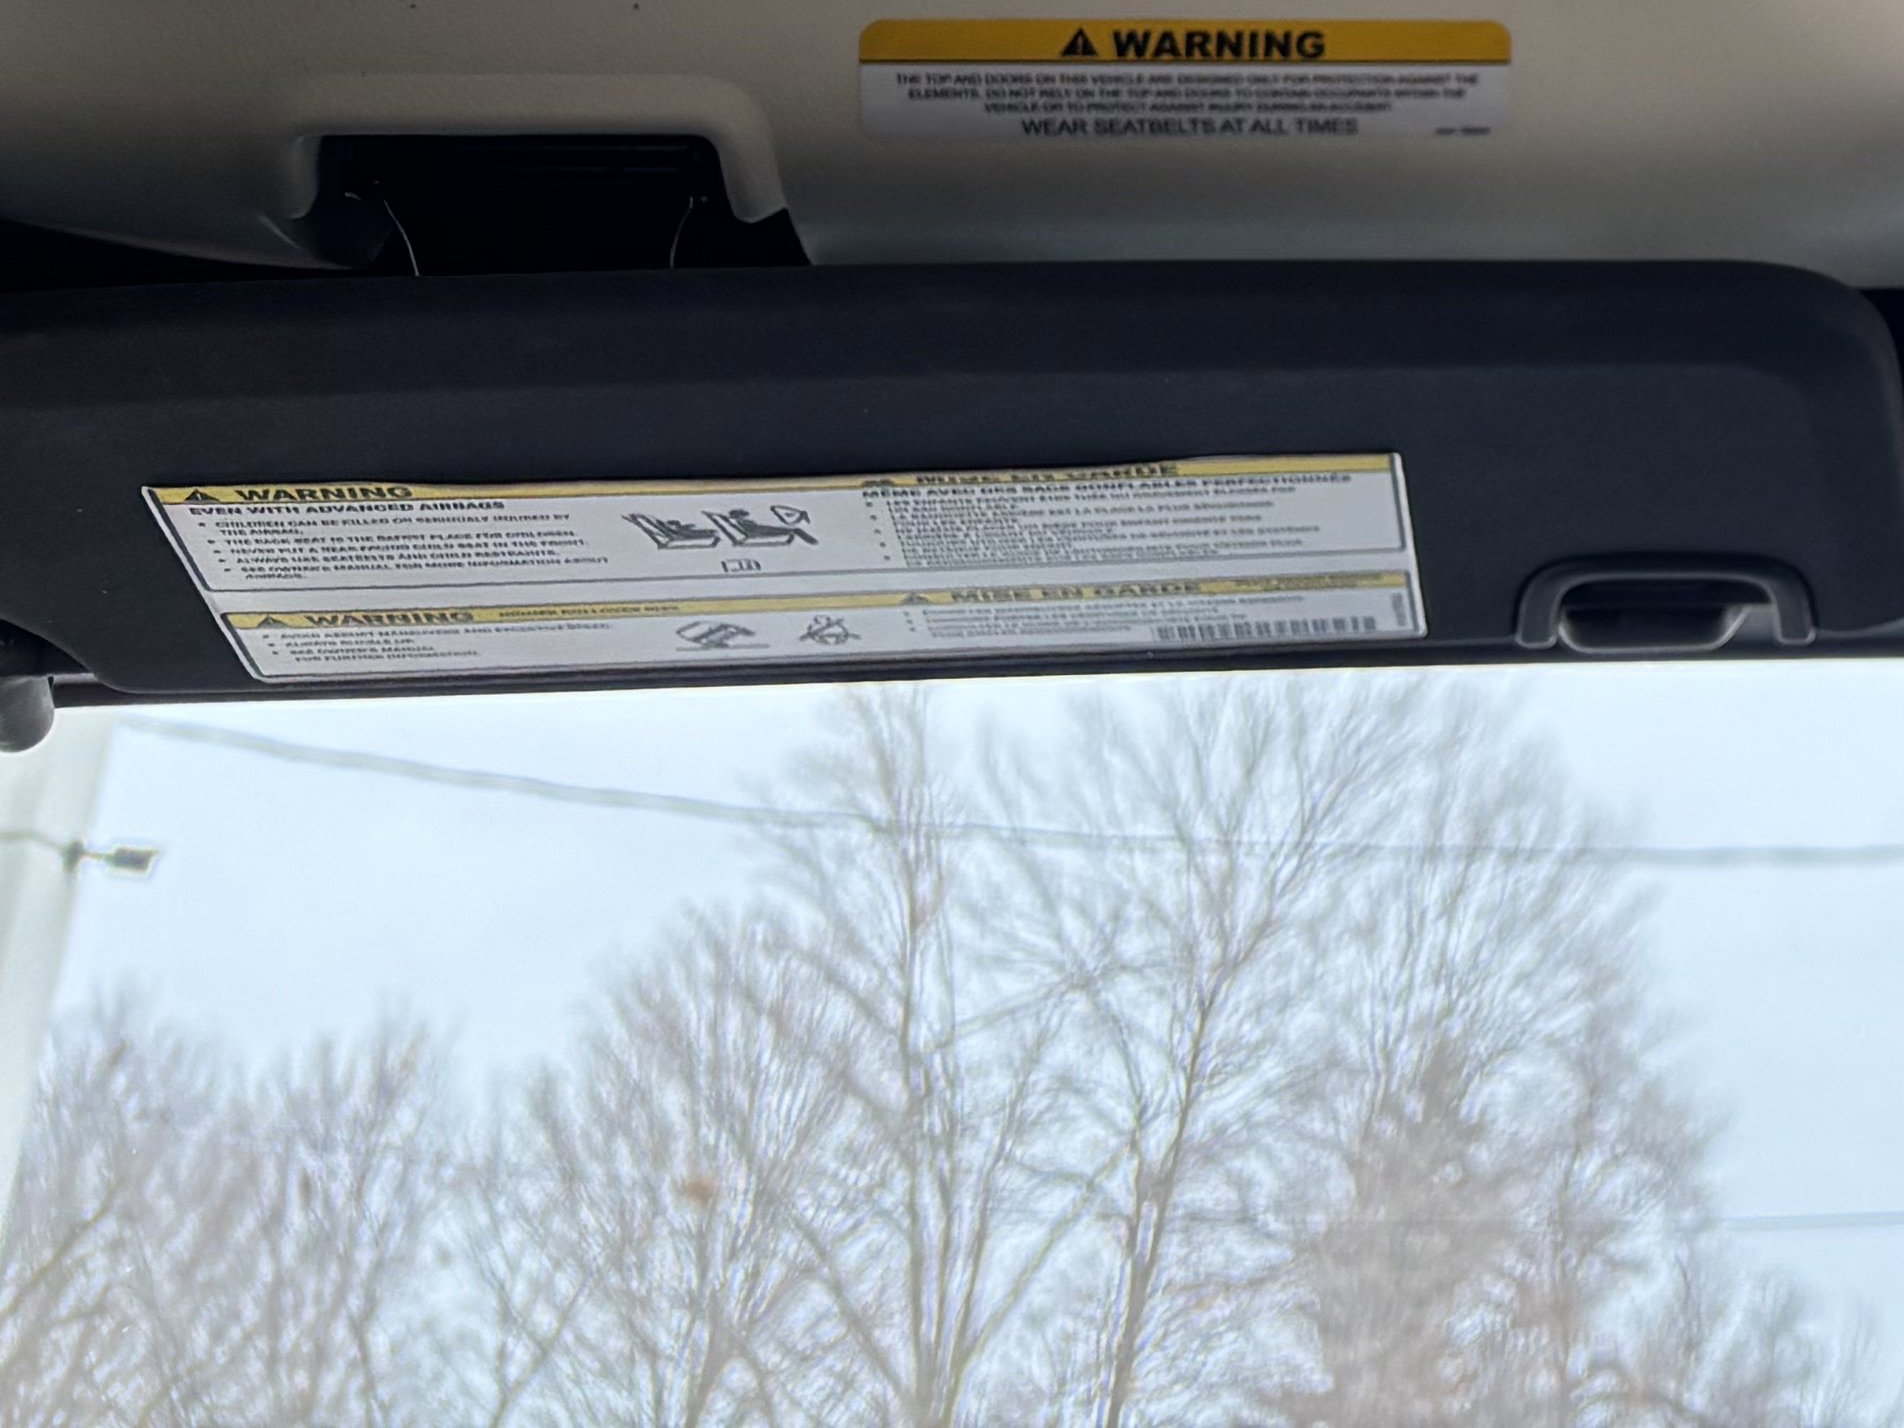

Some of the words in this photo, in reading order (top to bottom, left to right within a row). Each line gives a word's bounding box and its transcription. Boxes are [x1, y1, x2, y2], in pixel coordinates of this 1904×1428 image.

[1112, 29, 1325, 59] WARNING
[926, 73, 951, 85] TOP
[953, 73, 981, 85] AND
[1009, 87, 1035, 99] NOT
[1021, 118, 1087, 135] WEAR
[1094, 118, 1215, 135] SEATBELTS
[1218, 118, 1243, 135] AT
[1248, 118, 1285, 135] ALL
[1295, 118, 1358, 135] TIMES
[235, 486, 413, 501] WARNING
[188, 506, 242, 516] EVEN
[246, 505, 300, 515] WITH
[305, 502, 415, 514] ADVANCED
[303, 611, 474, 626] WARNING
